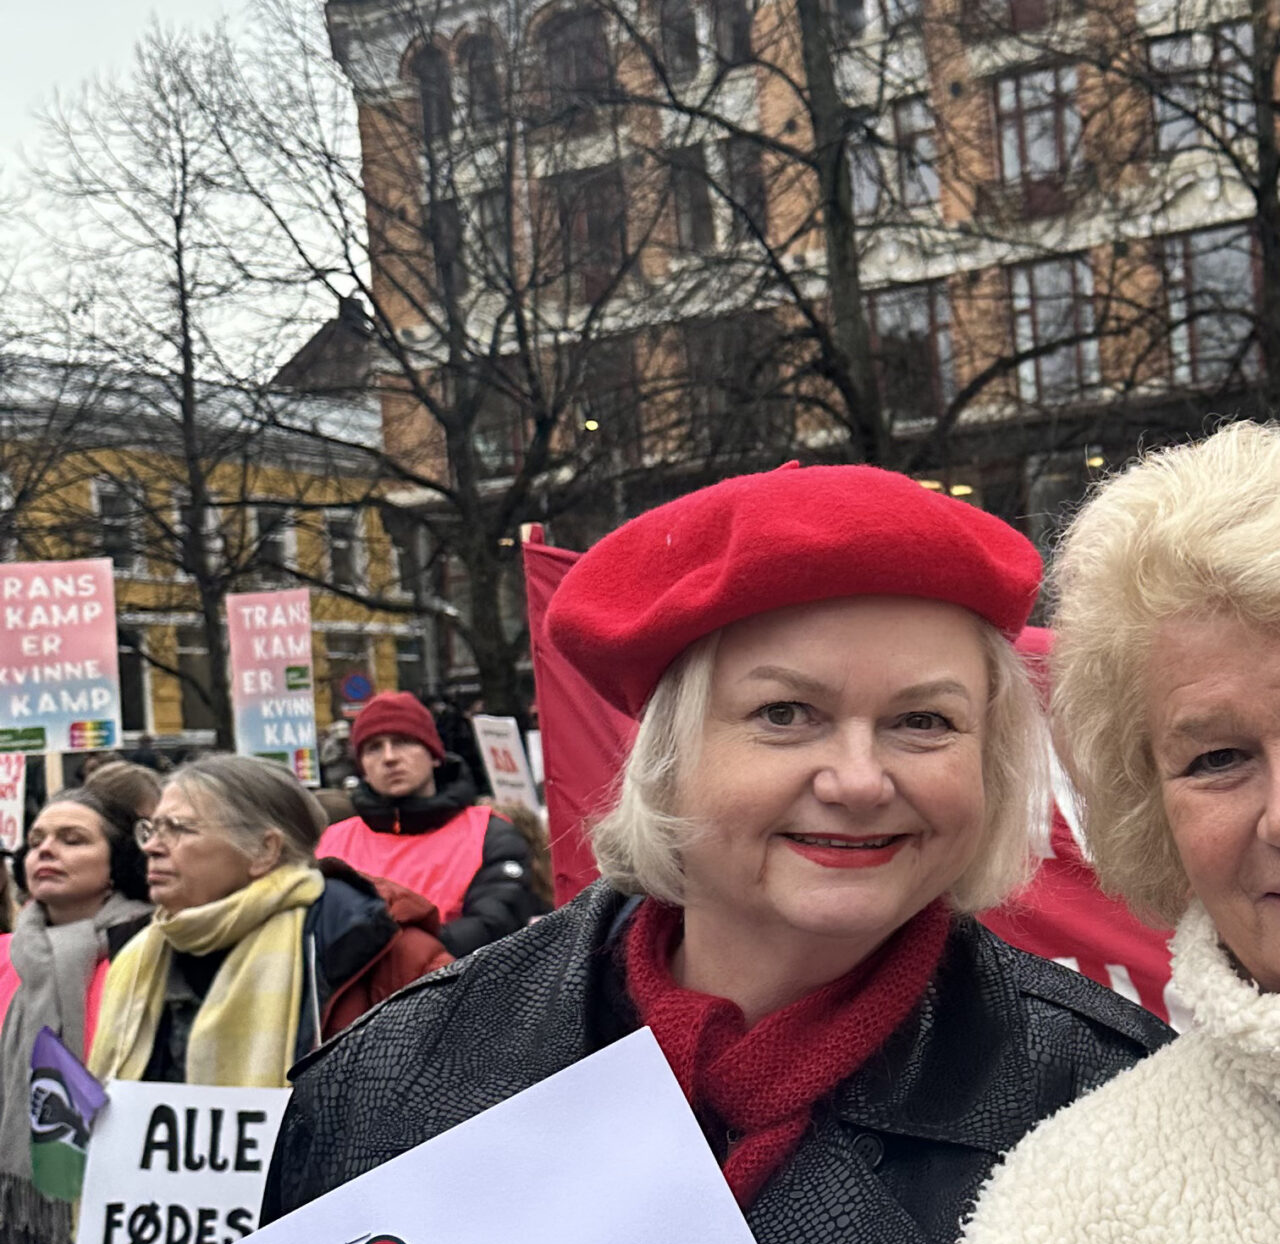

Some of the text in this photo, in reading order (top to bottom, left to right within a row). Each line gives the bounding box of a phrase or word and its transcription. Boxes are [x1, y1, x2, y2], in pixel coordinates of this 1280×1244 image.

[5, 601, 103, 630] KAMP
[22, 633, 63, 656] ER
[242, 668, 275, 694] ER
[10, 686, 112, 717] KAMP
[139, 1103, 267, 1172] ALLE
